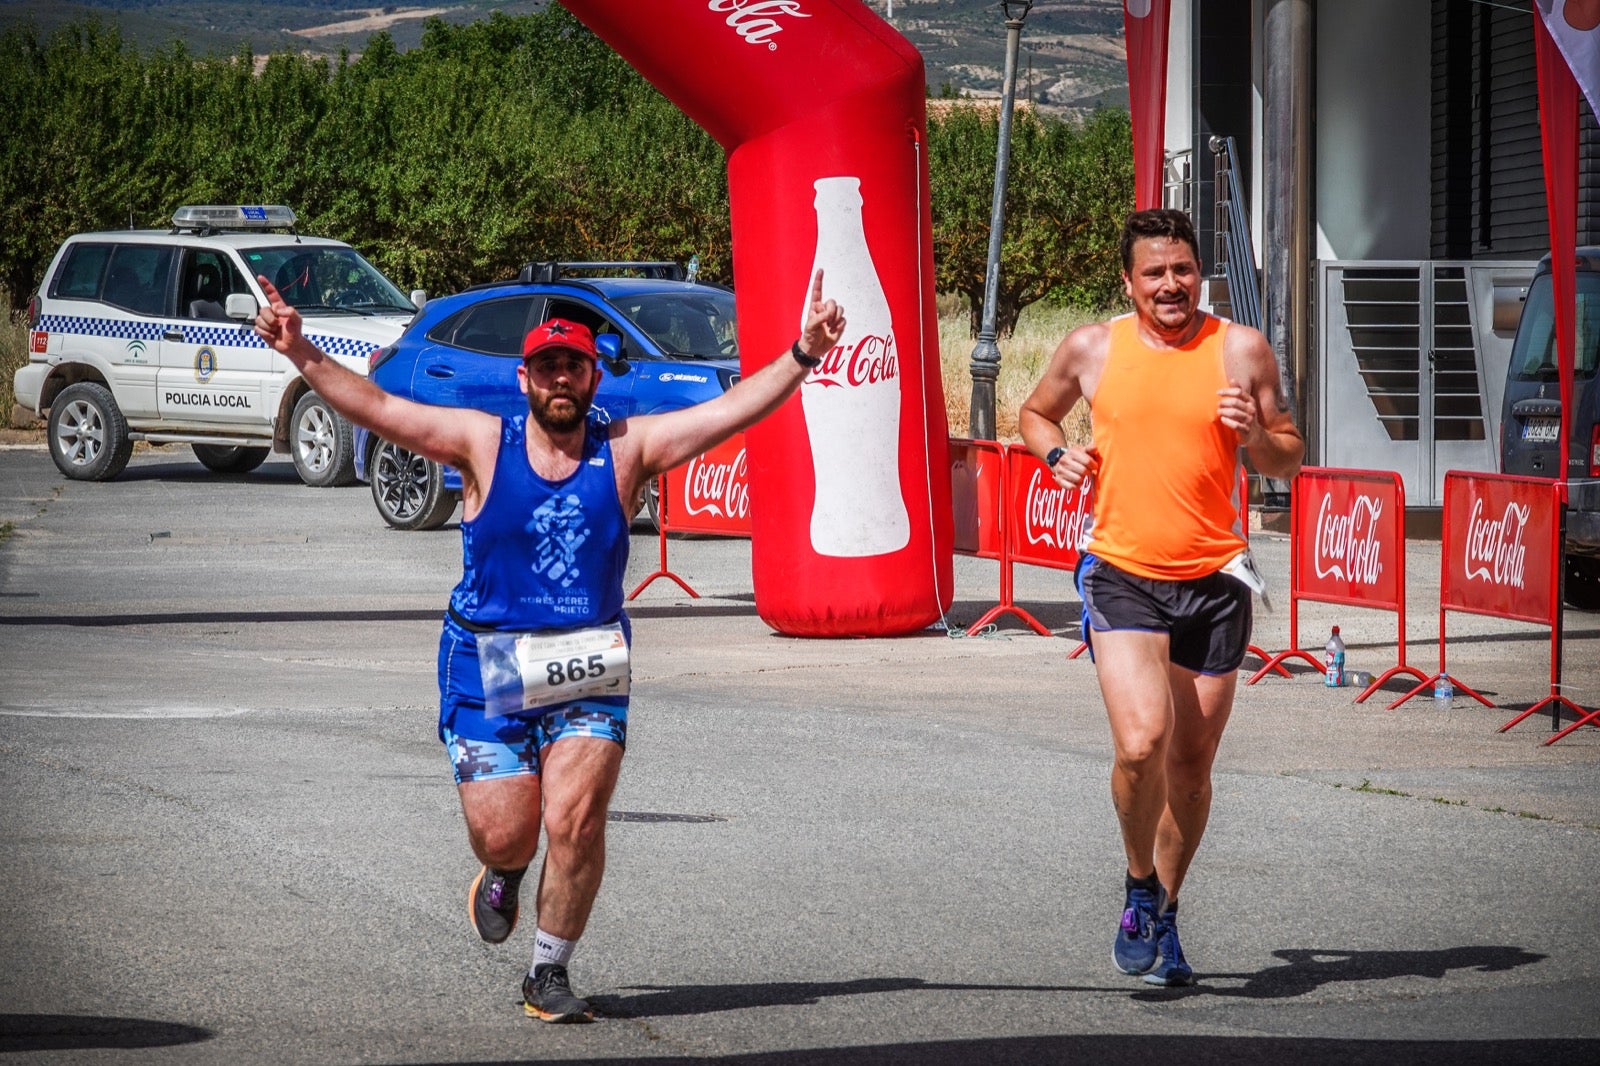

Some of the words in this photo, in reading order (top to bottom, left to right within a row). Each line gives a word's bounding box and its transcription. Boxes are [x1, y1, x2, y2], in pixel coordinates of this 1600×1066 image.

[36, 336, 47, 346] 112
[165, 392, 211, 407] POLICIA
[213, 394, 252, 408] LOCAL
[1314, 491, 1384, 585] Coca-Cola
[1464, 497, 1531, 590] Coca-Cola
[553, 605, 590, 614] PRIETO
[546, 653, 606, 687] 865
